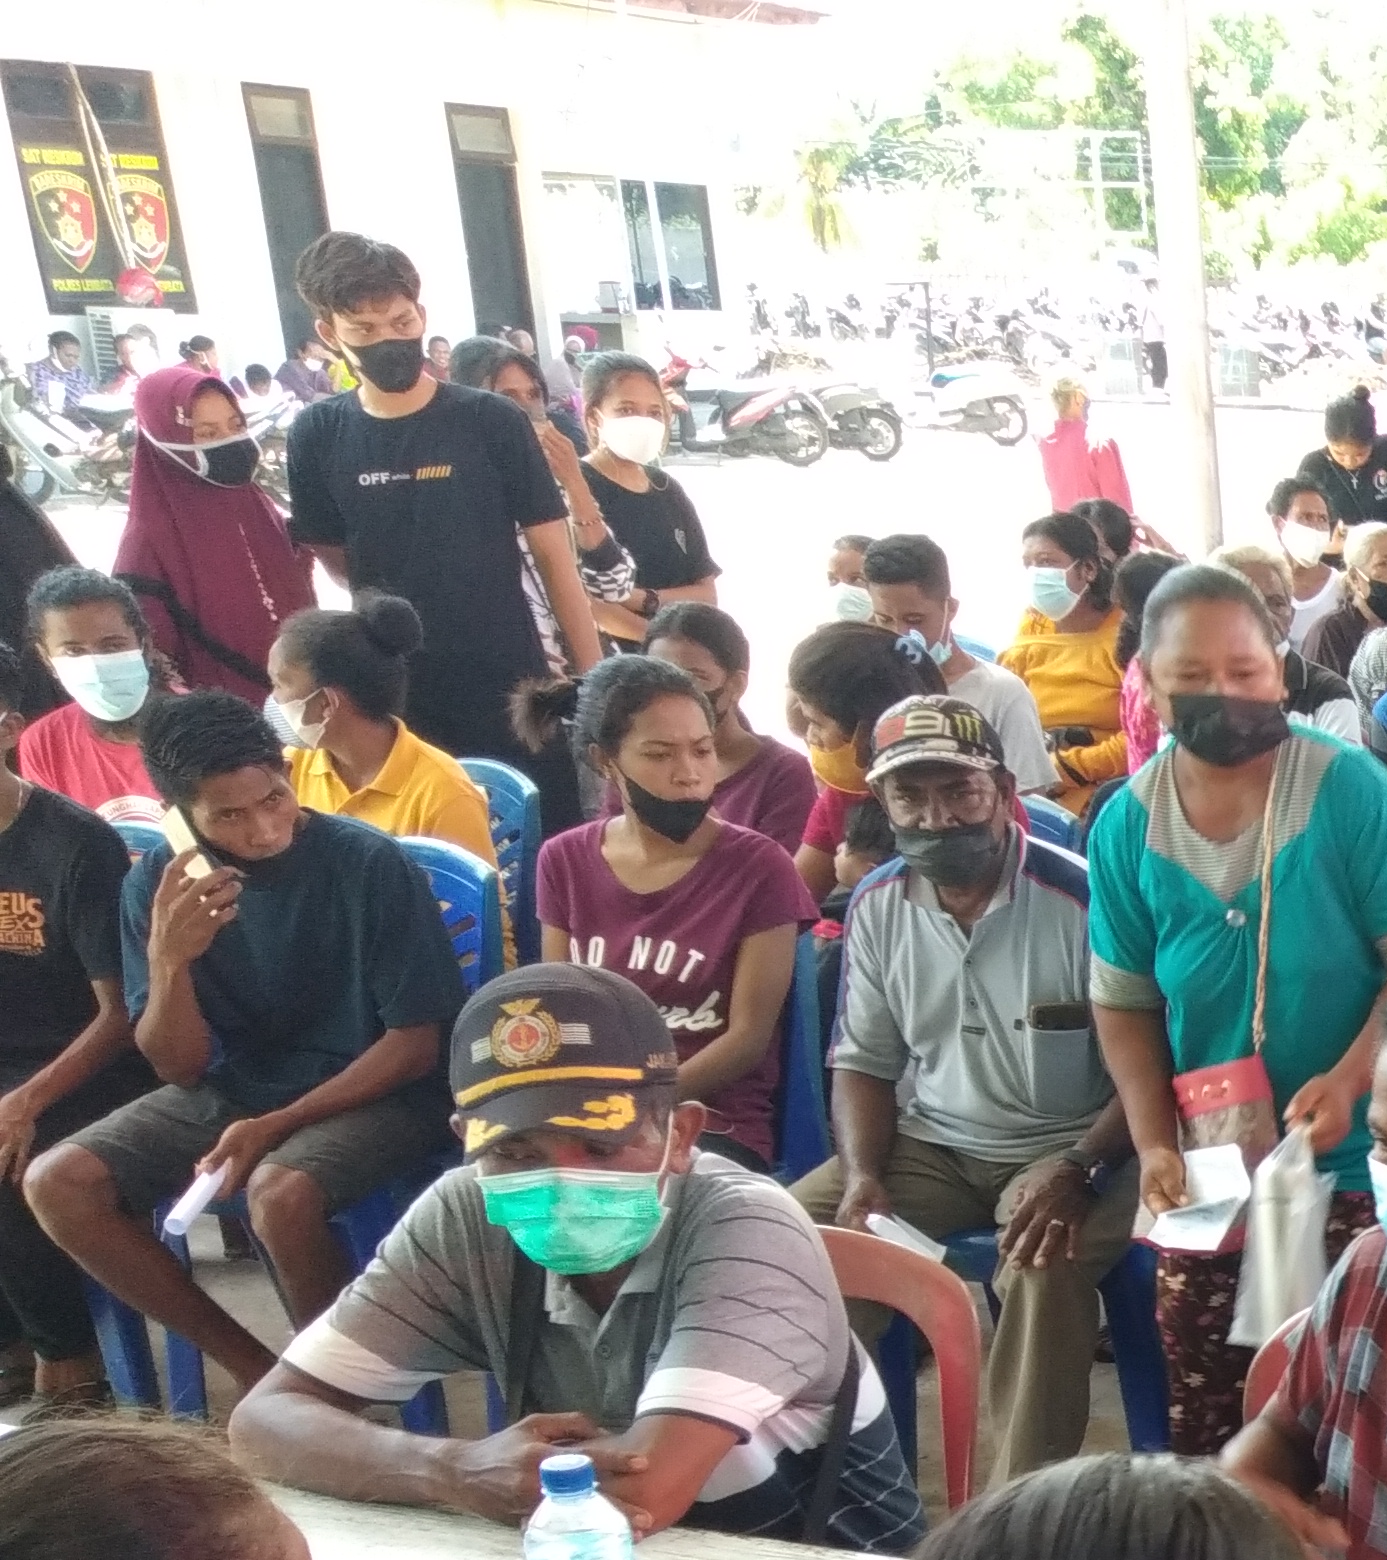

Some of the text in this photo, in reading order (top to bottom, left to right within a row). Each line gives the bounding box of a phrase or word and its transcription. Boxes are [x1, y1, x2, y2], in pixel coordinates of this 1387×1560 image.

[358, 472, 391, 487] OFF
[569, 934, 706, 984] DO NOT
